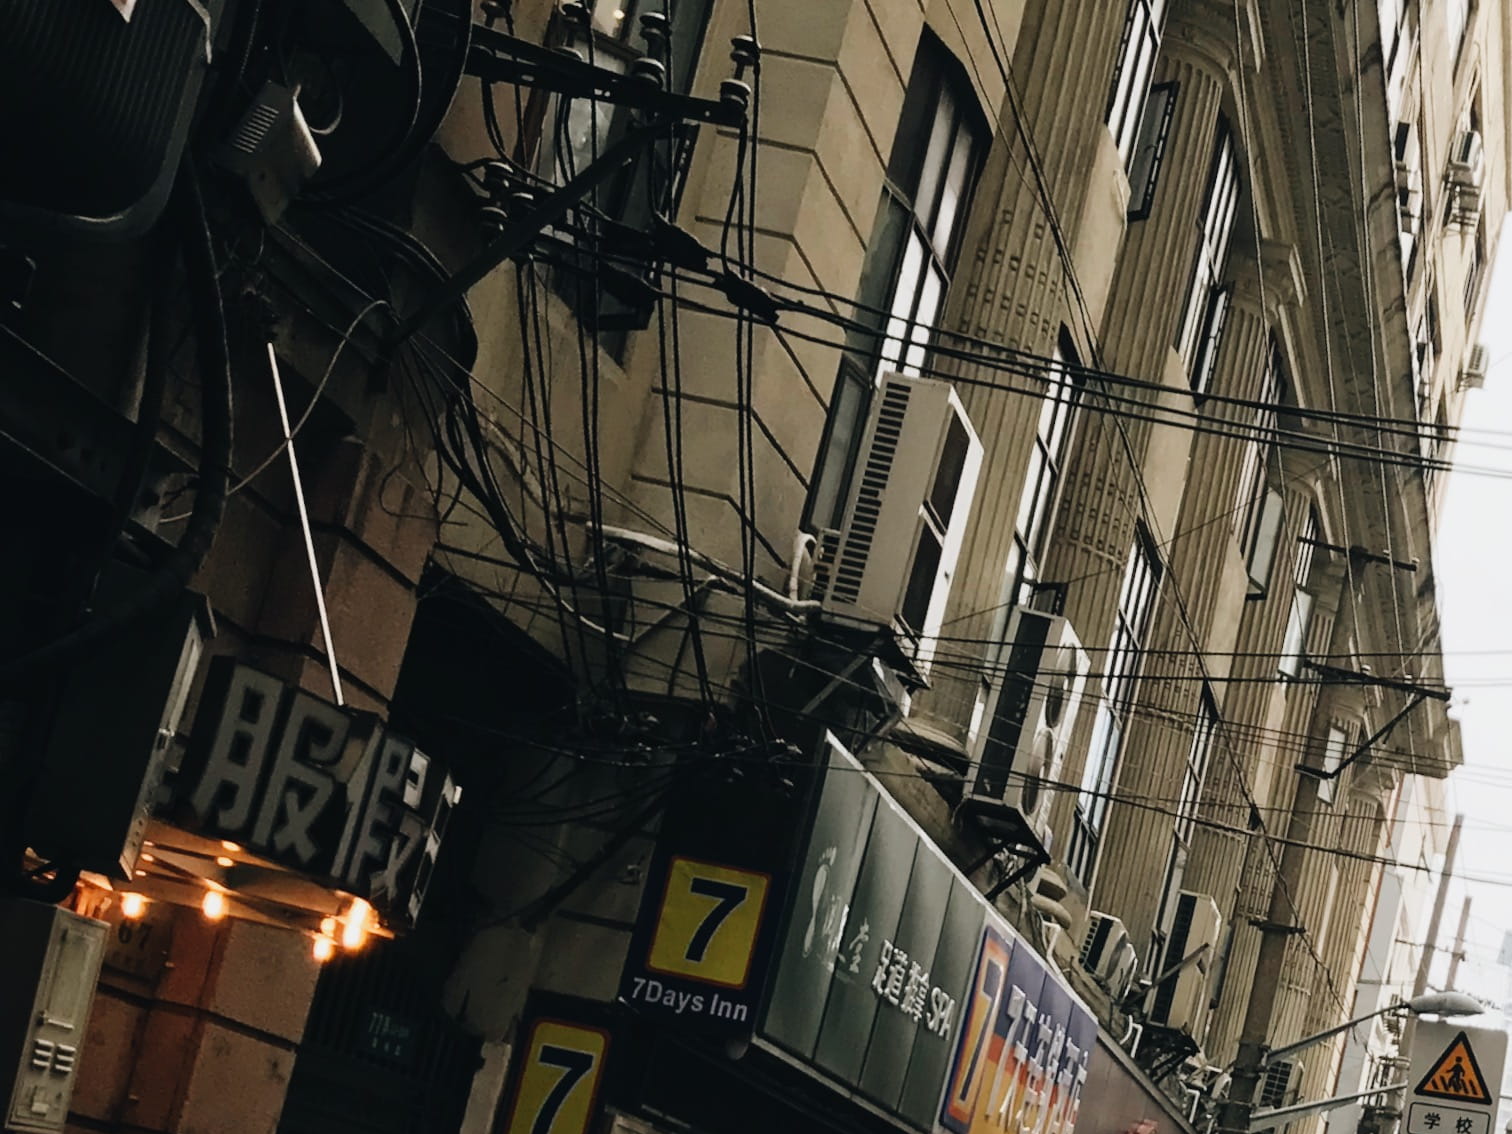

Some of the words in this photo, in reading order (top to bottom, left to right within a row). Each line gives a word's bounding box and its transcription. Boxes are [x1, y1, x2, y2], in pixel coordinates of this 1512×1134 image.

[684, 876, 749, 963] 7
[632, 977, 705, 1014] 7Days
[710, 993, 748, 1022] Inn
[926, 986, 956, 1041] SPA
